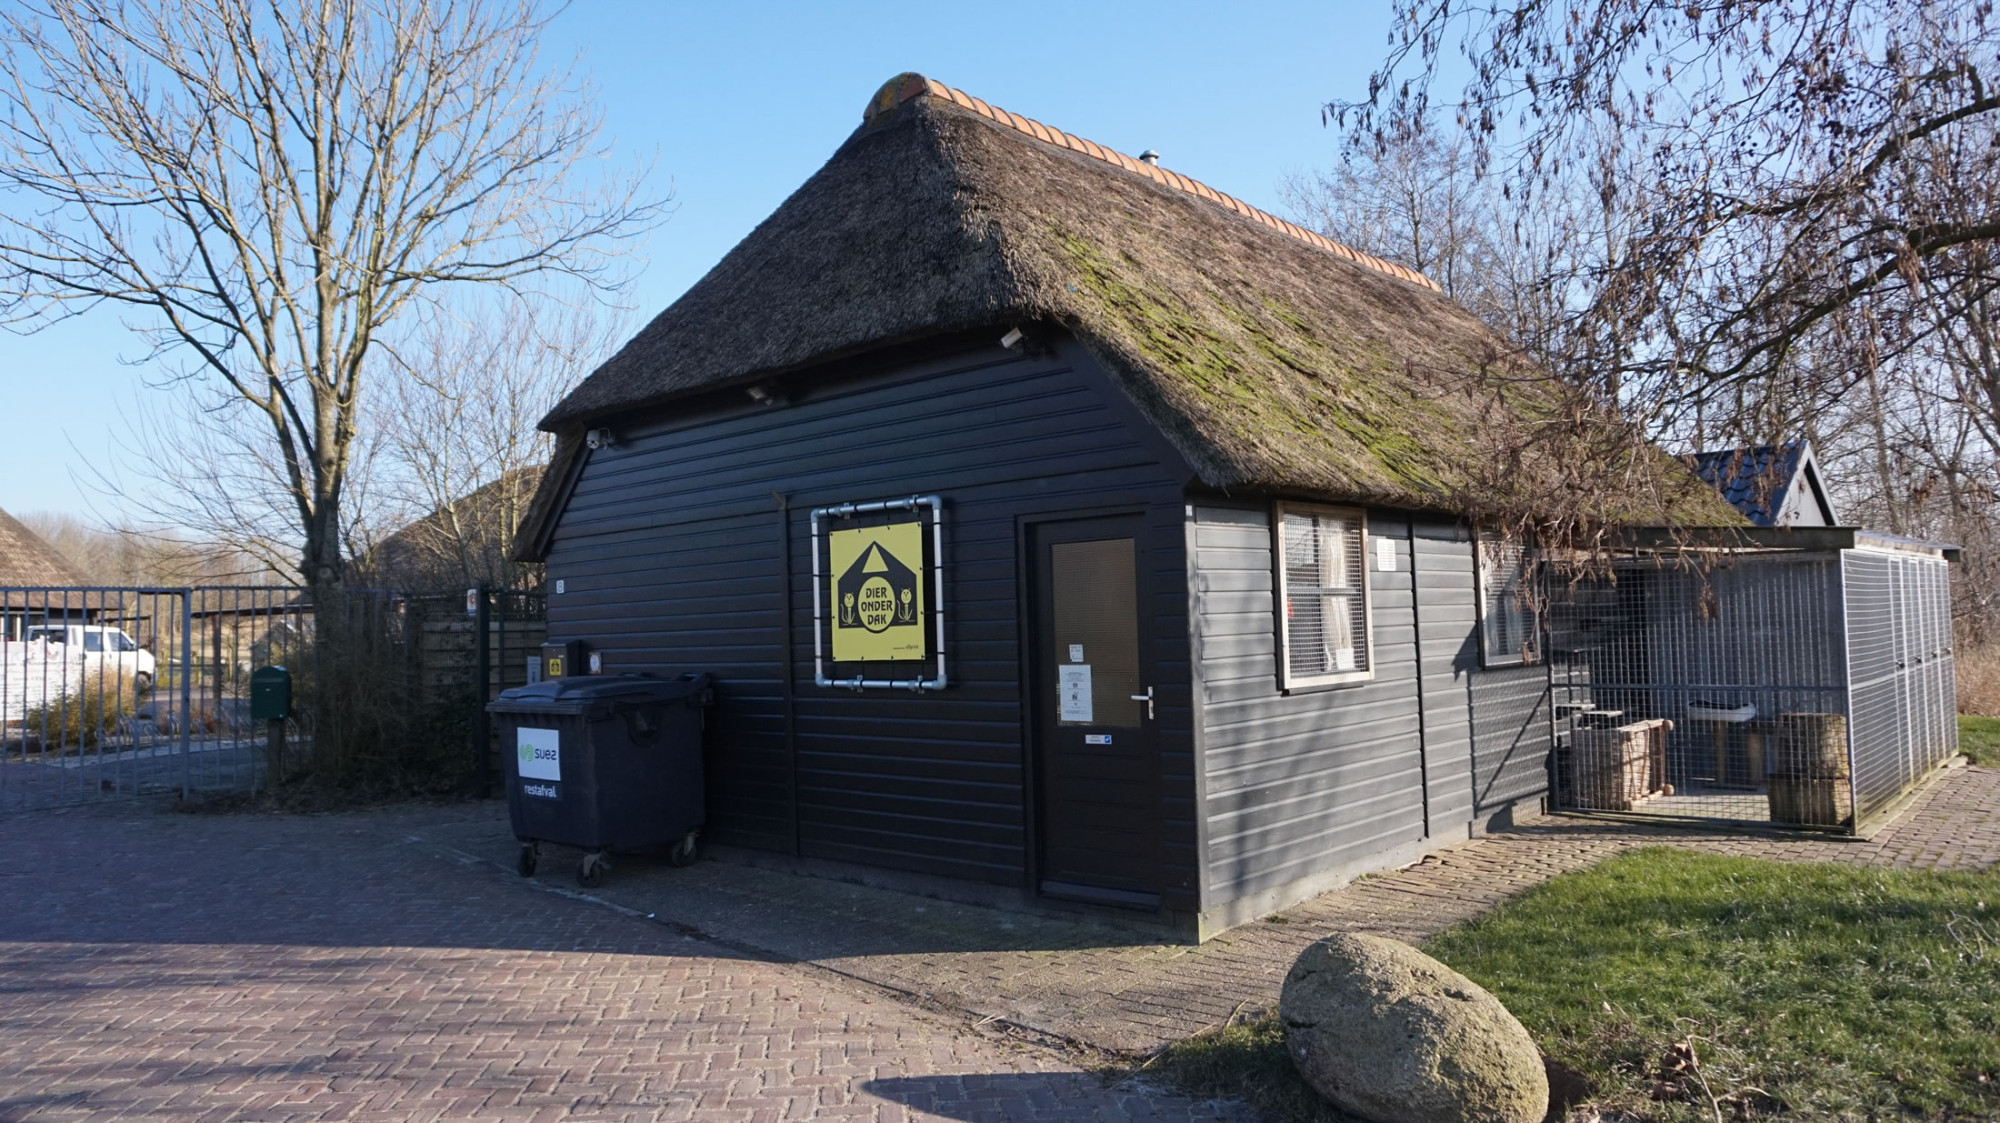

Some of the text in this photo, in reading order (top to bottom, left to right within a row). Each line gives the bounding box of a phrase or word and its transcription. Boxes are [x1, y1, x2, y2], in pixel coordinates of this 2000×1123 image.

[866, 587, 887, 598] DIER
[861, 600, 893, 612] ONDER
[867, 614, 887, 625] DAK
[534, 748, 557, 760] suez
[524, 784, 557, 798] restafval
